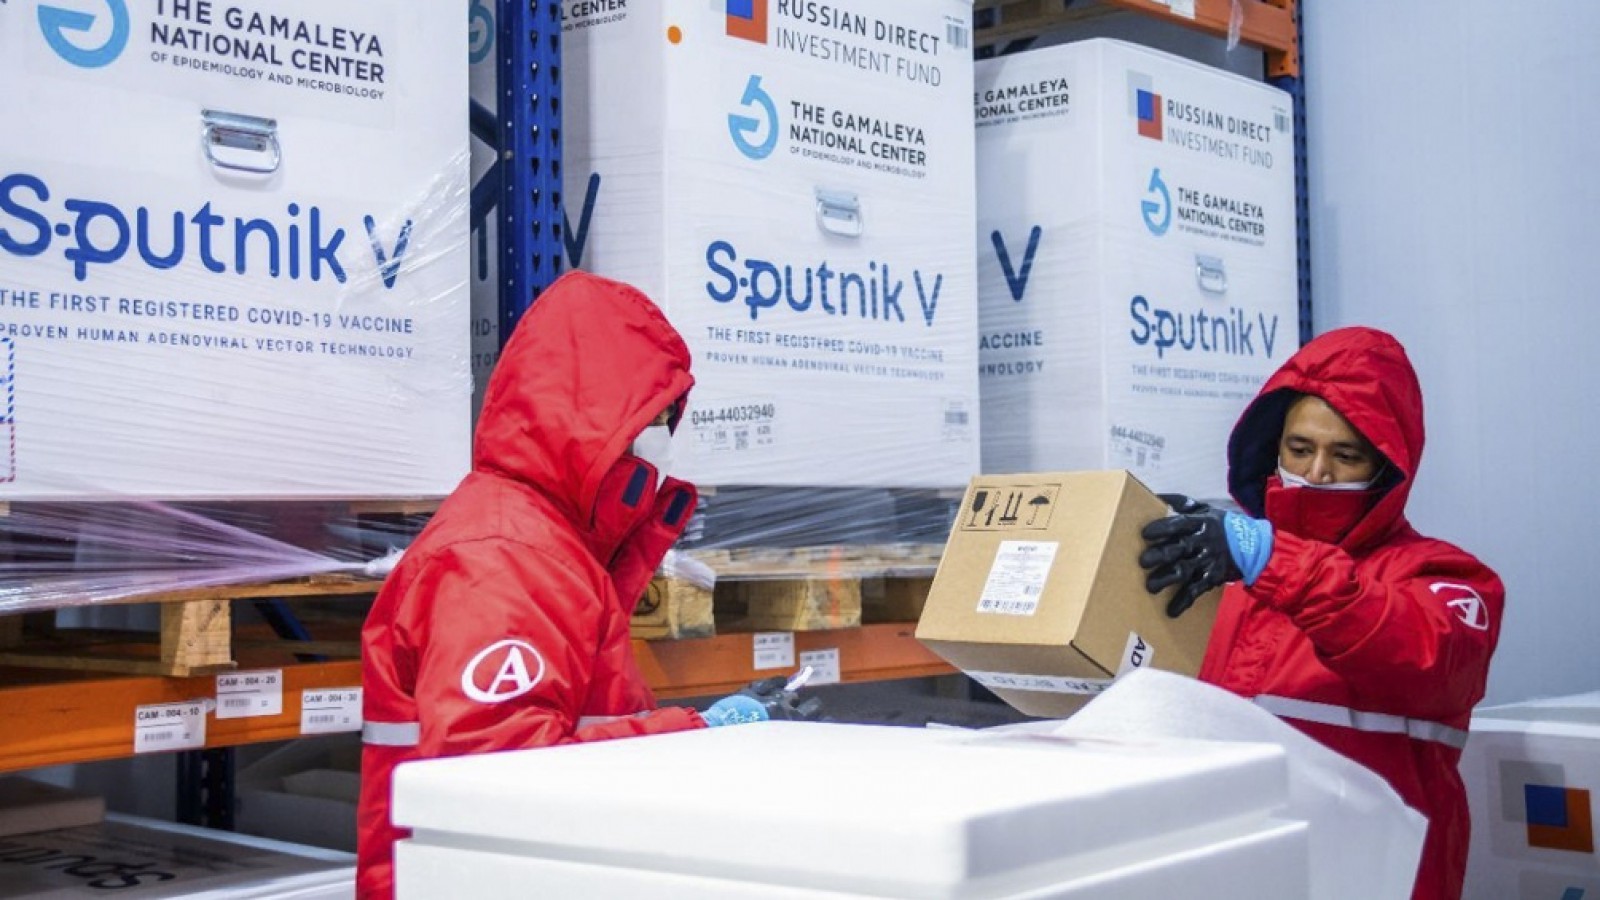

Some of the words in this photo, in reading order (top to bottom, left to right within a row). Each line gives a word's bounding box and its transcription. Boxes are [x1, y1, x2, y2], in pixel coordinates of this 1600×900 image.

[225, 7, 383, 57] GAMALEYA
[778, 0, 866, 36] RUSSIAN
[875, 20, 940, 56] DIRECT
[151, 22, 283, 66] NATIONAL
[291, 49, 384, 83] CENTER
[777, 27, 891, 73] INVESTMENT
[897, 57, 941, 87] FUND
[151, 51, 168, 62] OF
[173, 55, 264, 79] EPIDEMIOLOGY
[268, 72, 293, 85] AND
[297, 77, 384, 100] MICROBIOLOGY
[984, 78, 1069, 103] GAMALEYA
[791, 100, 825, 125] THE
[832, 110, 925, 145] GAMALEYA
[1018, 93, 1069, 112] CENTER
[1167, 98, 1224, 130] RUSSIAN
[1228, 115, 1271, 143] DIRECT
[790, 124, 866, 155] NATIONAL
[870, 141, 927, 166] CENTER
[1167, 126, 1240, 160] INVESTMENT
[1242, 144, 1273, 170] FUND
[1177, 206, 1226, 229] NATIONAL
[1228, 217, 1264, 237] CENTER
[1178, 187, 1199, 207] THE
[1203, 193, 1264, 220] GAMALEYA
[363, 214, 413, 288] V
[991, 226, 1042, 302] V
[50, 293, 111, 313] FIRST
[118, 297, 239, 321] REGISTERED
[247, 307, 332, 328] COVID-19
[338, 315, 413, 334] VACCINE
[913, 269, 943, 327] V
[77, 328, 139, 342] HUMAN
[147, 332, 248, 349] ADENOVIRAL
[256, 339, 315, 353] VECTOR
[320, 342, 414, 358] TECHNOLOGY
[707, 326, 731, 341] THE
[736, 329, 771, 344] FIRST
[775, 333, 844, 352] REGISTERED
[1259, 312, 1279, 360] V
[138, 710, 158, 720] CAM
